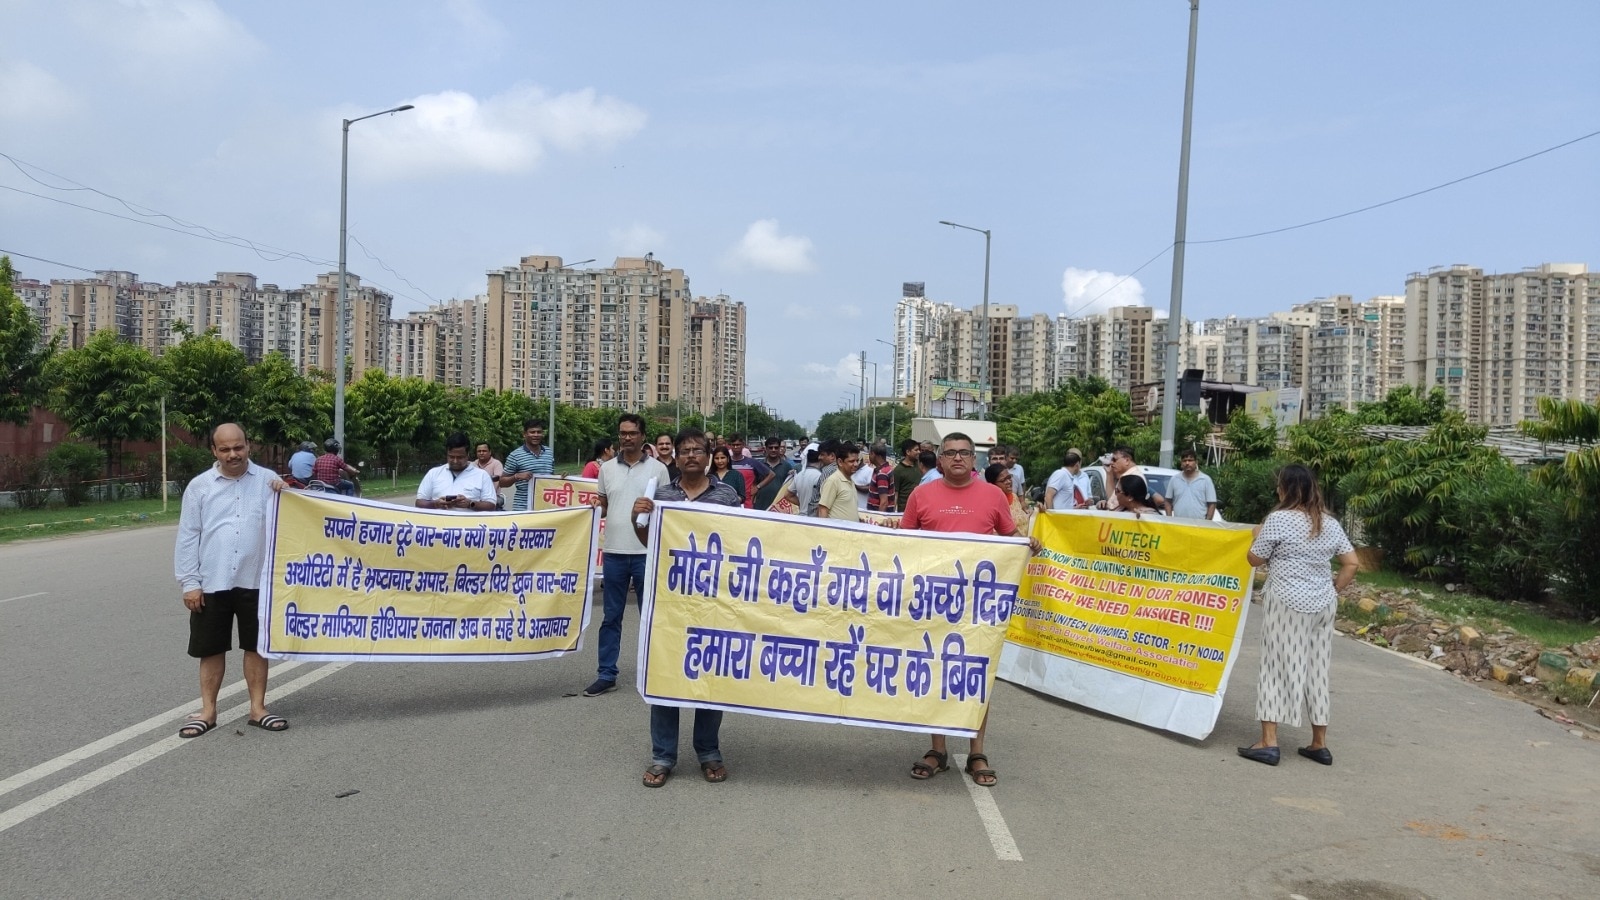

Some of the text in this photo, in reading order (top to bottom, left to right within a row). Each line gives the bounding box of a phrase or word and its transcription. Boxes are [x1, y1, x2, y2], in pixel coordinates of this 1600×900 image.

[324, 512, 556, 561] सपने हजार टूटे बार-बार क्यों चुप है सरकार
[1101, 546, 1151, 562] UNIHOMES
[285, 553, 579, 605] अथोरिटी में है भ्रष्टाचार अपार, बिल्डर पिये खून बार-बार
[668, 532, 1018, 627] मोदी जी कहाँ गये वो अच्छे दिन
[1047, 567, 1068, 581] WE
[1069, 573, 1097, 590] WILL
[1098, 579, 1128, 596] LIVE
[1129, 584, 1145, 598] IN
[1146, 587, 1173, 601] OUR
[1174, 590, 1228, 611] HOMES
[1231, 598, 1240, 613] ?
[1052, 553, 1072, 565] NOW
[1071, 558, 1089, 570] STILL
[1126, 566, 1132, 577] &
[1134, 566, 1169, 582] WAITING
[1171, 572, 1188, 584] FOR
[1188, 574, 1205, 585] OUR
[1205, 575, 1240, 591] HOMES.
[285, 602, 571, 641] बिल्डर माफिया होशियार जनता अब न सहे ये अत्याचार
[1032, 583, 1075, 603] UNITECH
[1076, 595, 1095, 609] WE
[1096, 599, 1130, 616] NEED
[1134, 606, 1191, 627] ANSWER
[1194, 614, 1215, 632] !!!!
[1053, 614, 1088, 631] UNITECH
[1132, 631, 1170, 650] SECTOR
[1178, 642, 1196, 656] 117
[1196, 646, 1225, 663] NOIDA
[1063, 629, 1094, 644] Buyers
[1097, 637, 1133, 653] Welfare
[1135, 648, 1199, 669] Association
[684, 624, 989, 704] हमारा बच्चा रहें घर के बिन
